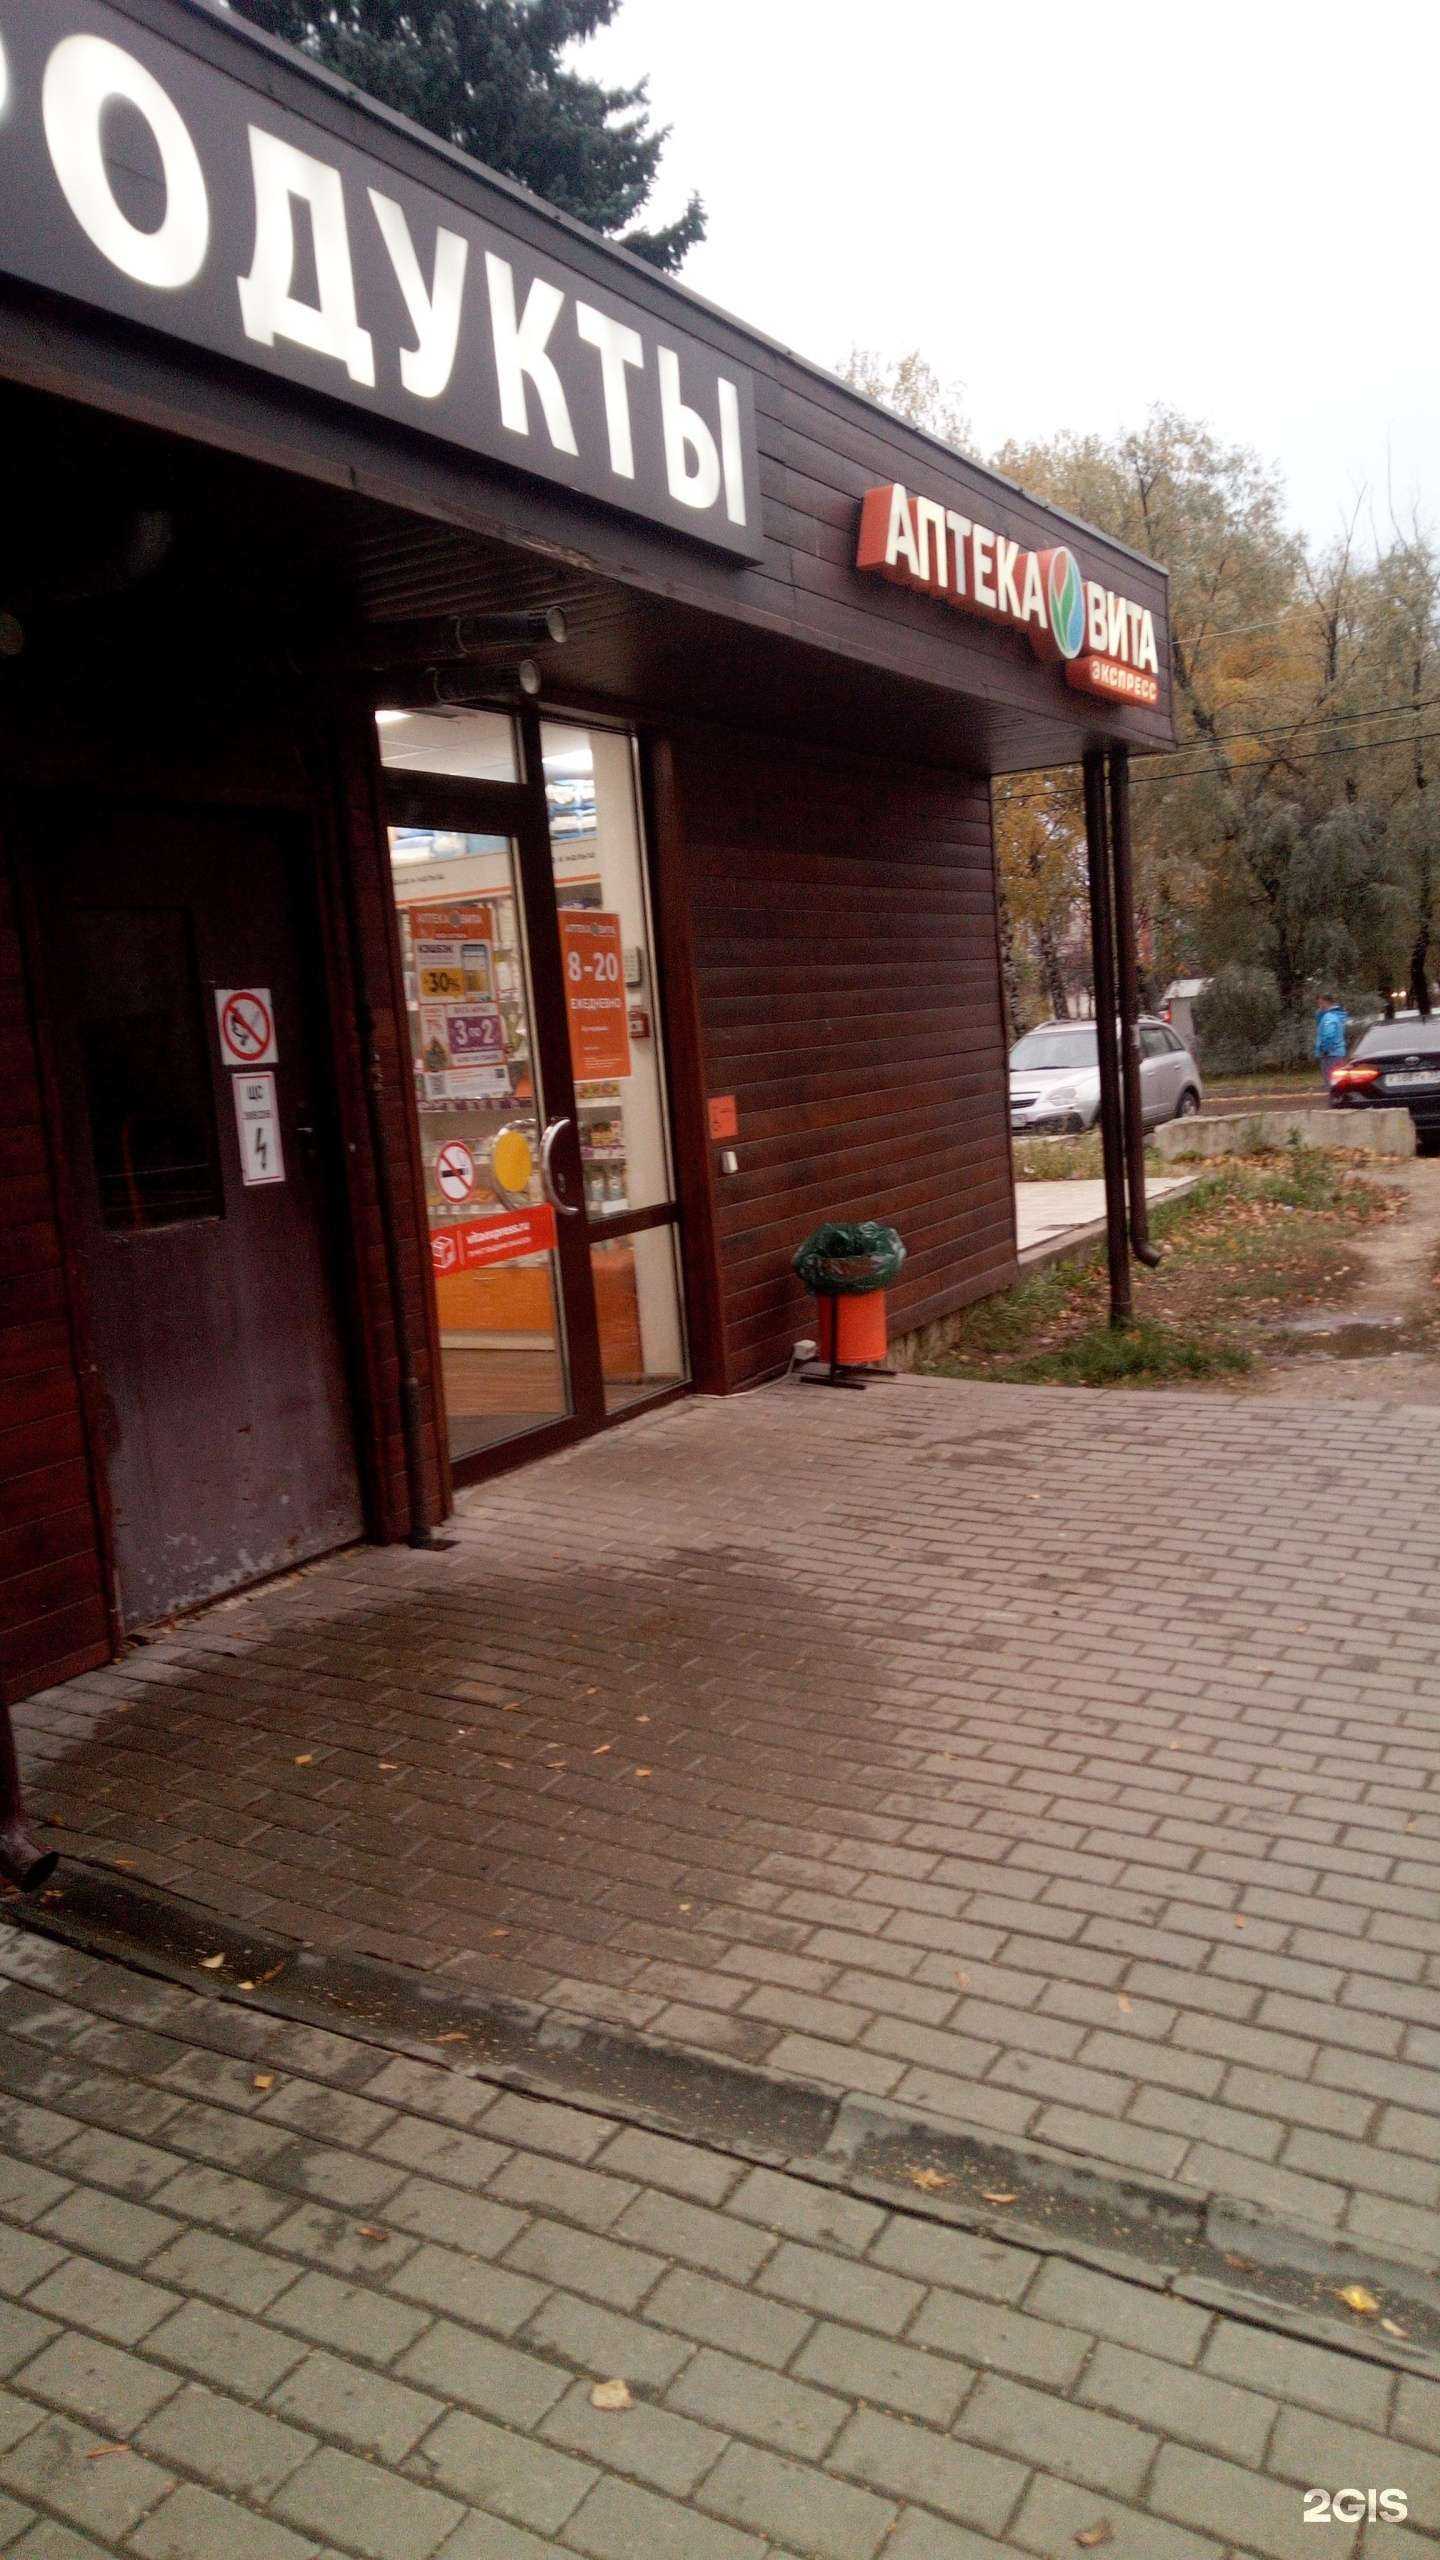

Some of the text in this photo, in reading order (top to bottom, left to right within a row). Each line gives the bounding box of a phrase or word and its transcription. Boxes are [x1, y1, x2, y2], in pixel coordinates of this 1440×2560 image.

[0, 33, 746, 527] ОДУКТЫ
[885, 483, 1159, 674] АПТЕКА ВИТА
[1090, 659, 1158, 701] ЭКСПРЕСС
[567, 951, 619, 982] 8-20
[570, 998, 622, 1011] ЕЖЕДНЕВНО
